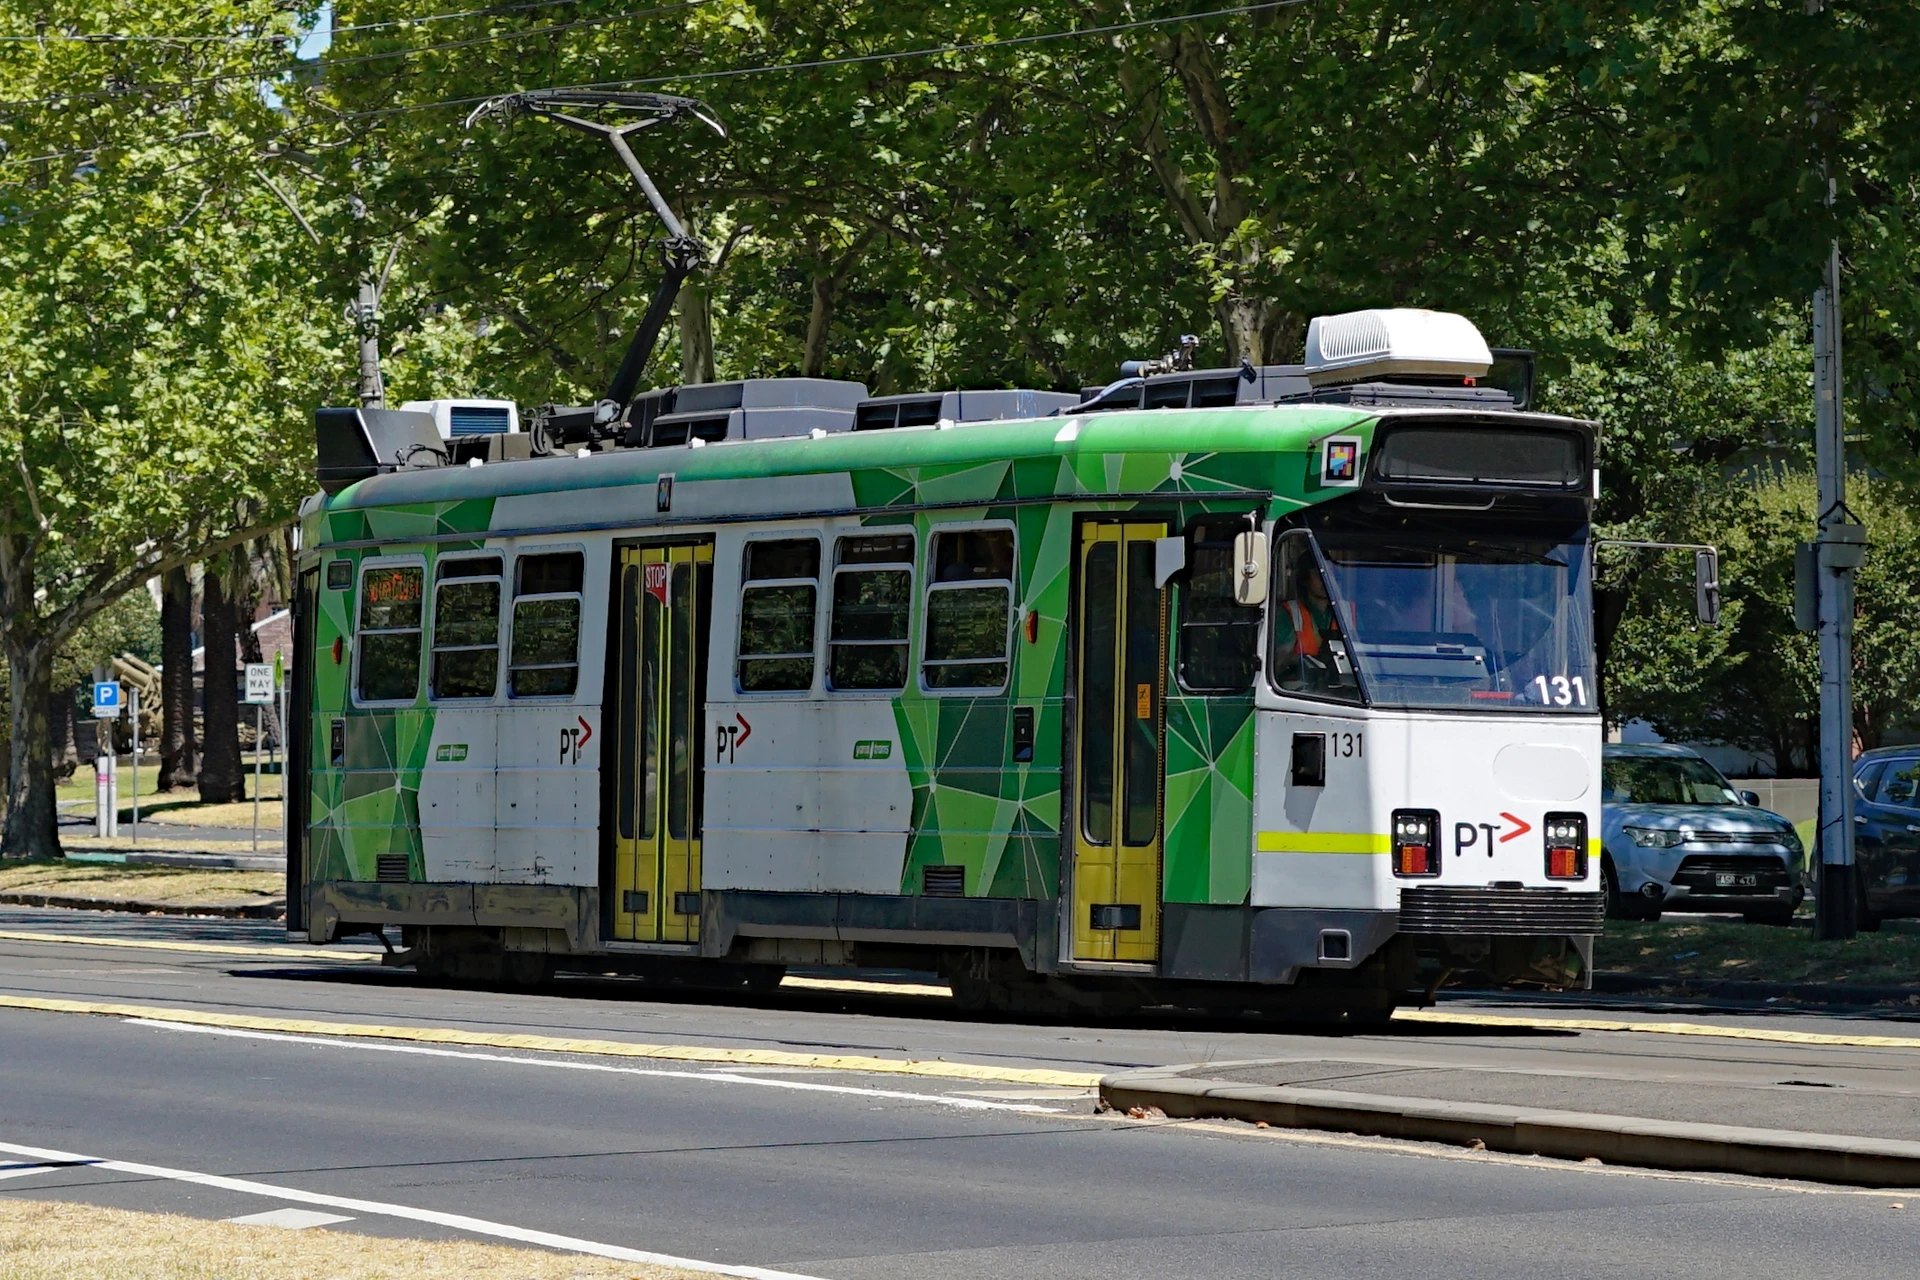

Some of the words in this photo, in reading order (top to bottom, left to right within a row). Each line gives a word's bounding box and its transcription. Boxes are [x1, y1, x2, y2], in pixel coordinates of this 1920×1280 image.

[645, 565, 666, 588] STOP
[250, 667, 271, 677] ONE
[249, 679, 271, 689] WAY
[1535, 675, 1587, 706] 131
[100, 687, 113, 703] P
[1331, 732, 1363, 758] 131
